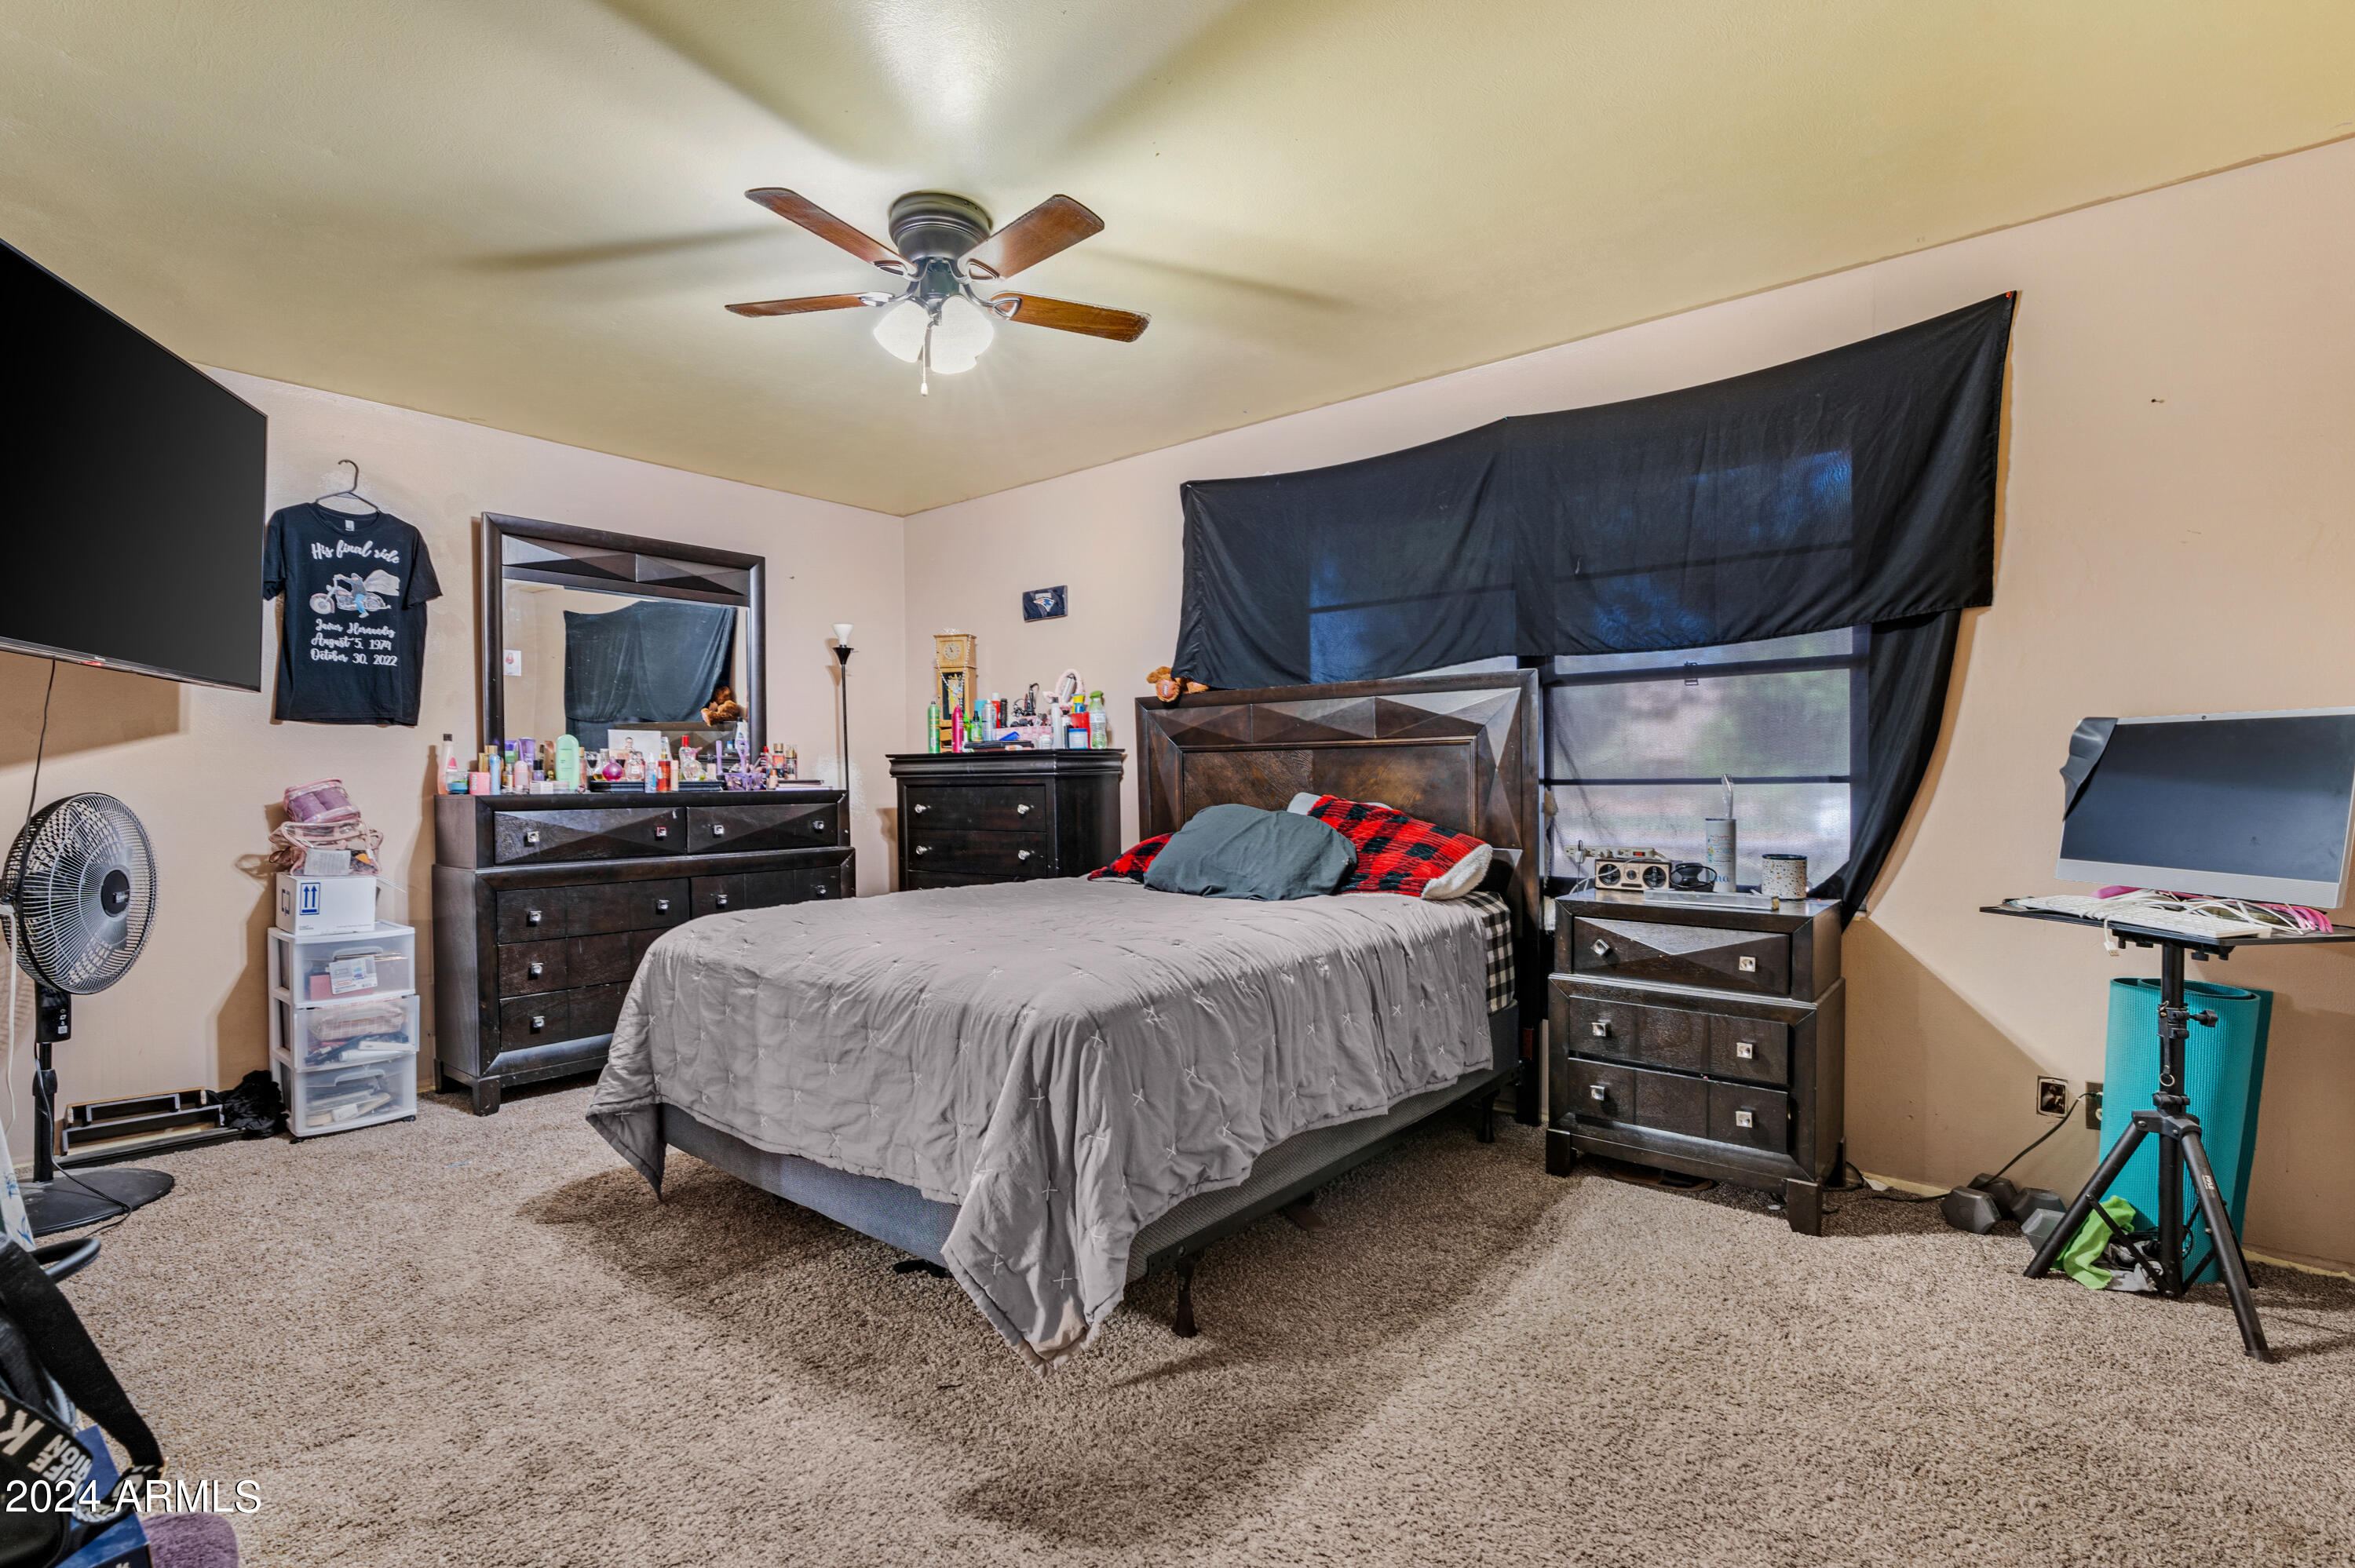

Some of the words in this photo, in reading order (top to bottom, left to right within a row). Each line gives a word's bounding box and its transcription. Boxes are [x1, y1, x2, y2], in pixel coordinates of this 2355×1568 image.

[311, 542, 334, 560] His
[336, 539, 373, 558] final
[374, 549, 400, 563] ride
[311, 632, 351, 648] August
[310, 648, 349, 662] October
[372, 655, 398, 666] 2022
